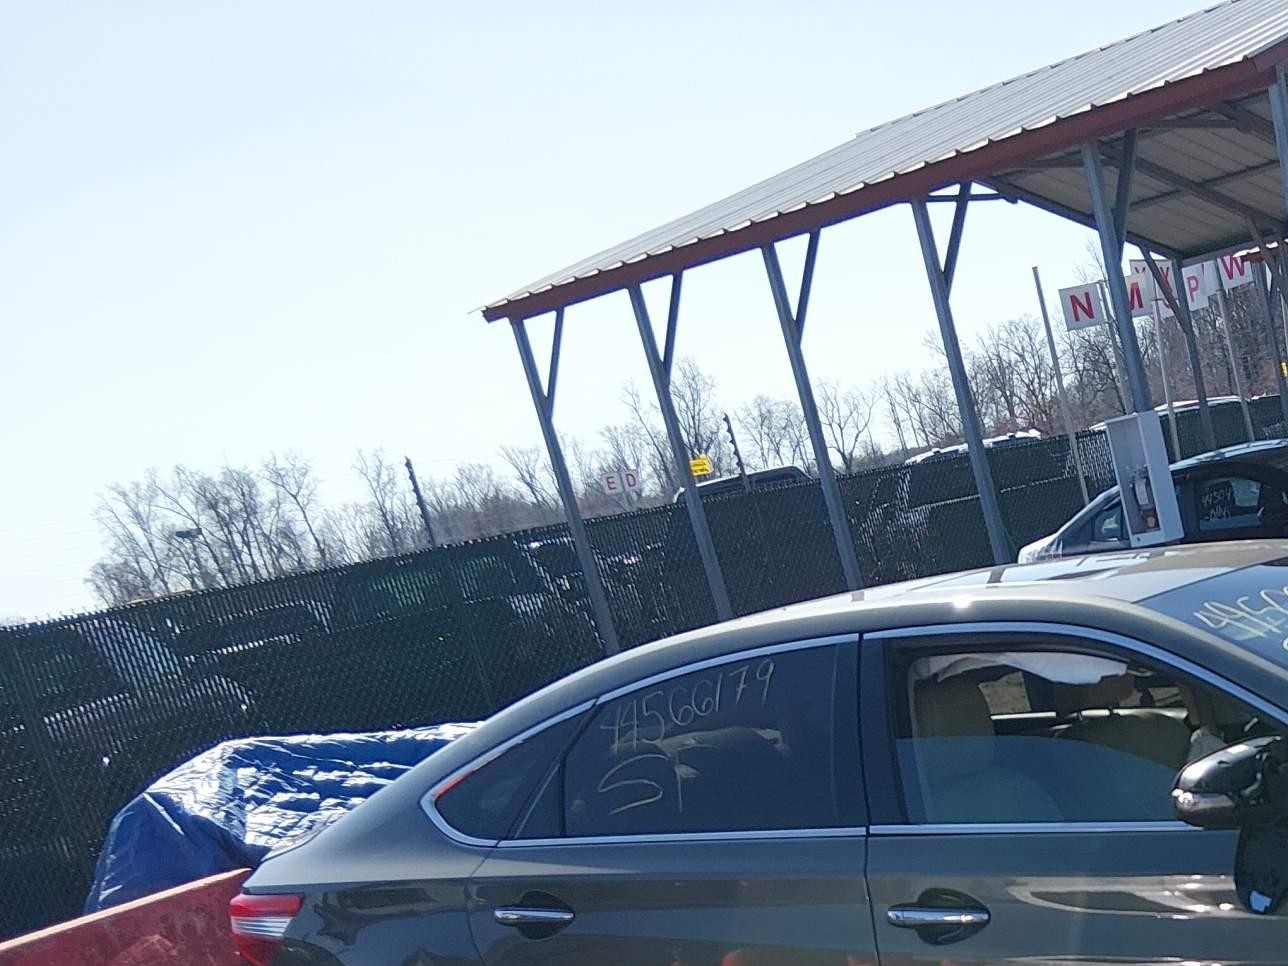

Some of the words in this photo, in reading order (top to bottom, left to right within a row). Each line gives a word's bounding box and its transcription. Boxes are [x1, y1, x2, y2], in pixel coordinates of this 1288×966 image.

[1219, 256, 1247, 281] W
[1187, 275, 1200, 303] P
[1069, 291, 1096, 322] N
[606, 475, 617, 491] E
[625, 473, 637, 488] D
[599, 657, 775, 755] 44566179
